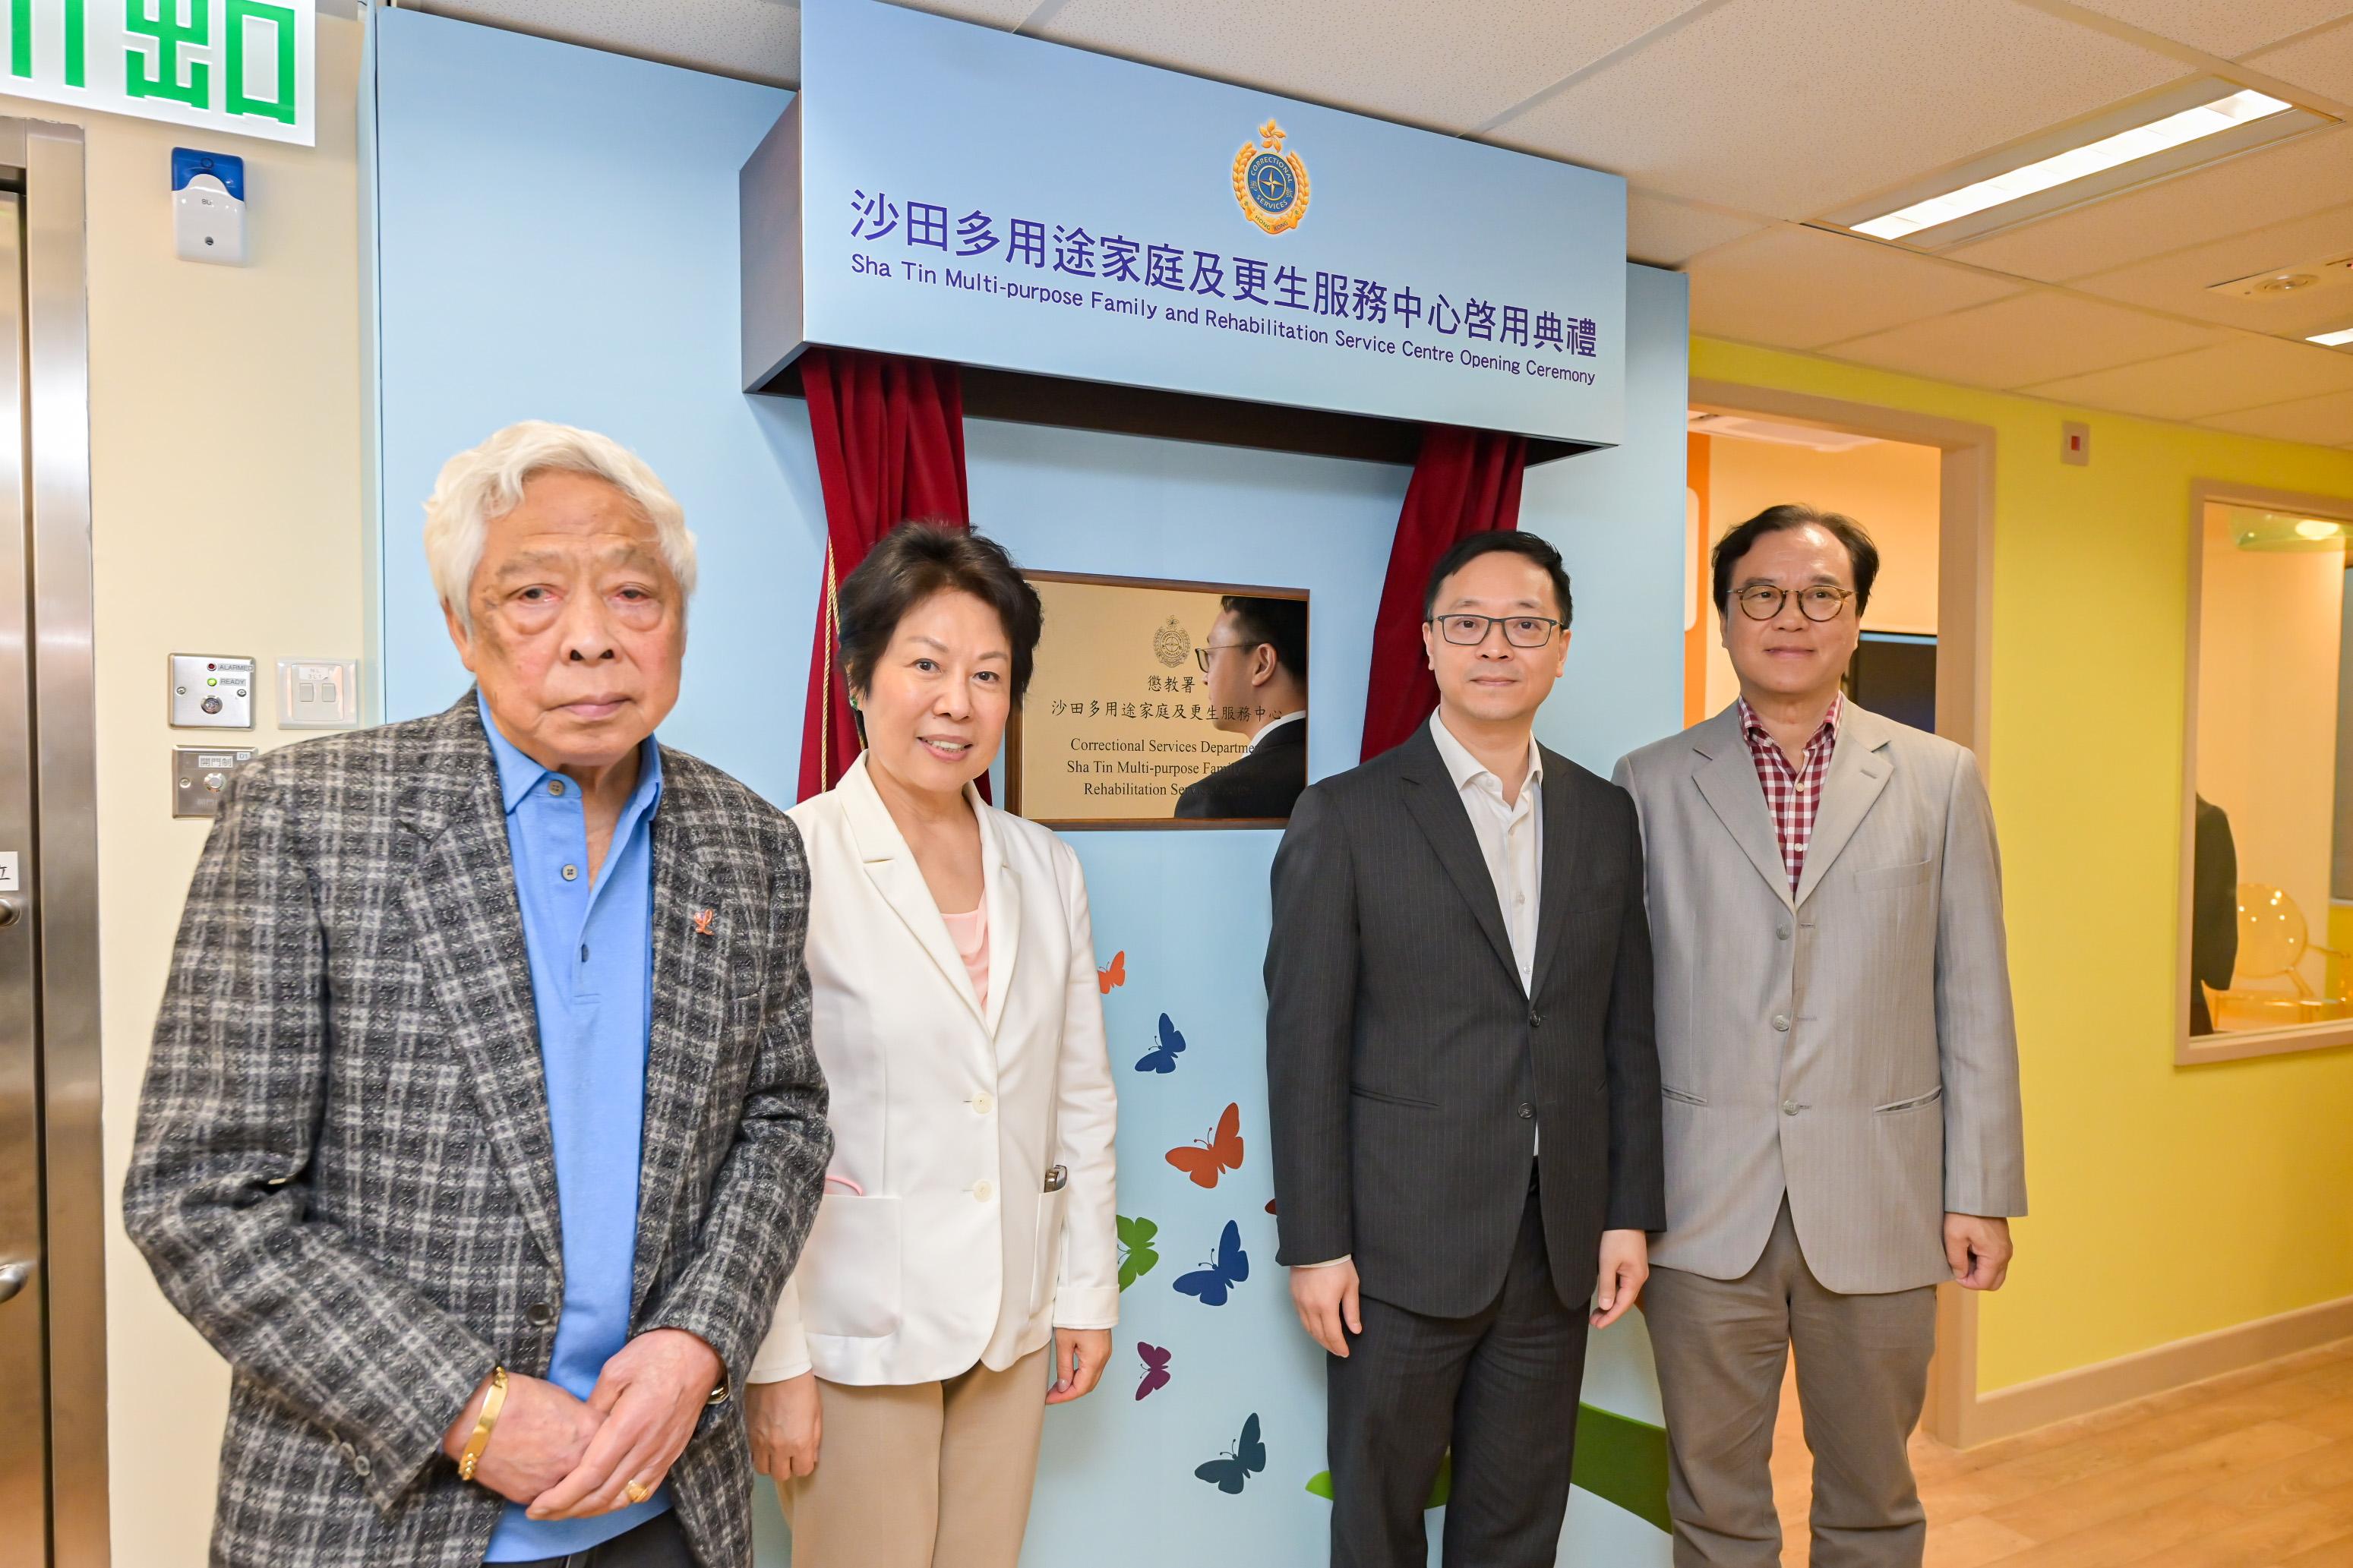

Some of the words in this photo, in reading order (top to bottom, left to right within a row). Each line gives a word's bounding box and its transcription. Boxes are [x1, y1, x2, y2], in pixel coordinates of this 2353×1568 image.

[126, 0, 296, 125] 出口
[1251, 156, 1293, 182] CORRECTIONAL
[1256, 194, 1288, 210] SERVICES
[1255, 215, 1271, 231] HONG
[1274, 220, 1289, 232] KONG
[851, 254, 892, 278] Sha
[902, 261, 936, 285] Tin
[946, 268, 1083, 307] Multi-purpose
[1092, 292, 1158, 320] Family
[1166, 308, 1199, 324] and
[1206, 310, 1328, 344] Rehabilitation
[1336, 330, 1396, 355] Service
[1403, 341, 1454, 363] Centre
[1461, 350, 1521, 375] Opening
[1527, 360, 1596, 386] Ceremony
[1148, 674, 1195, 694] 懲教署
[1051, 699, 1282, 722] 沙田多用途家庭及更生服務中心
[1070, 737, 1145, 752] Correctional
[1148, 740, 1197, 752] Services
[1201, 741, 1265, 756] Departmen
[1067, 760, 1089, 773] Sha
[1094, 761, 1113, 773] Tin
[1117, 761, 1199, 777] Multi-purpose
[1084, 783, 1167, 796] Rehabilitation
